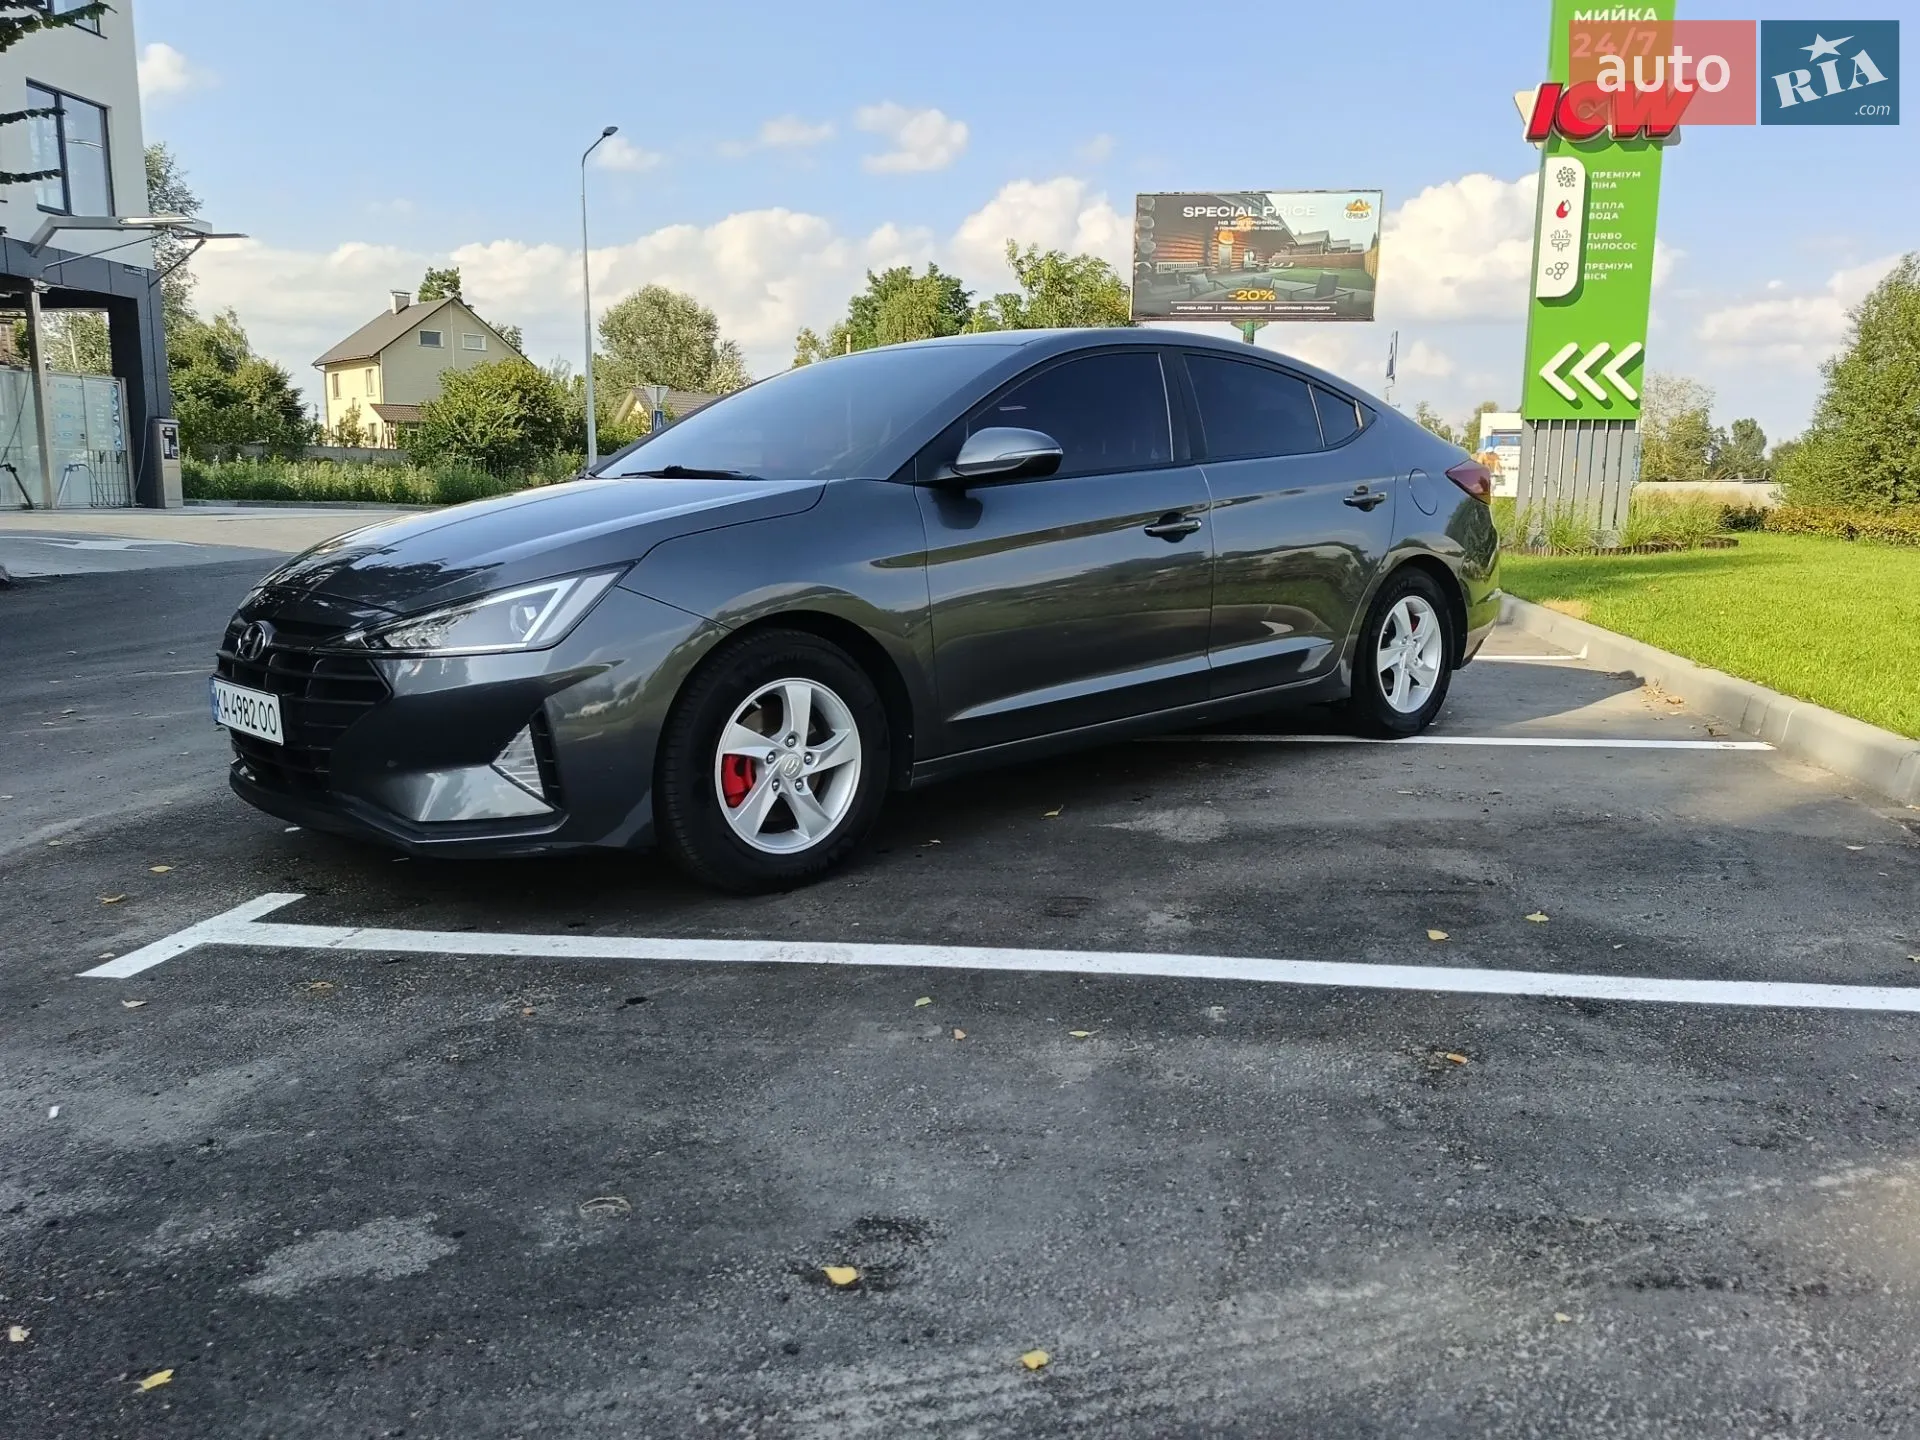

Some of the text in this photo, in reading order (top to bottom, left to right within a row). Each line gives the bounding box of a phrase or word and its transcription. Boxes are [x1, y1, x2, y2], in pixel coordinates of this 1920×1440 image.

[1574, 5, 1658, 24] МИЙКА
[1572, 27, 1657, 59] 24/7
[1526, 80, 1700, 140] ICW
[1592, 171, 1641, 179] ПРЕМІУМ
[1182, 206, 1317, 218] SPECIAL PRICE
[1589, 212, 1619, 220] ВОДА
[1588, 232, 1622, 240] TURBO
[1228, 290, 1276, 300] -20%
[232, 693, 258, 730] 4982
